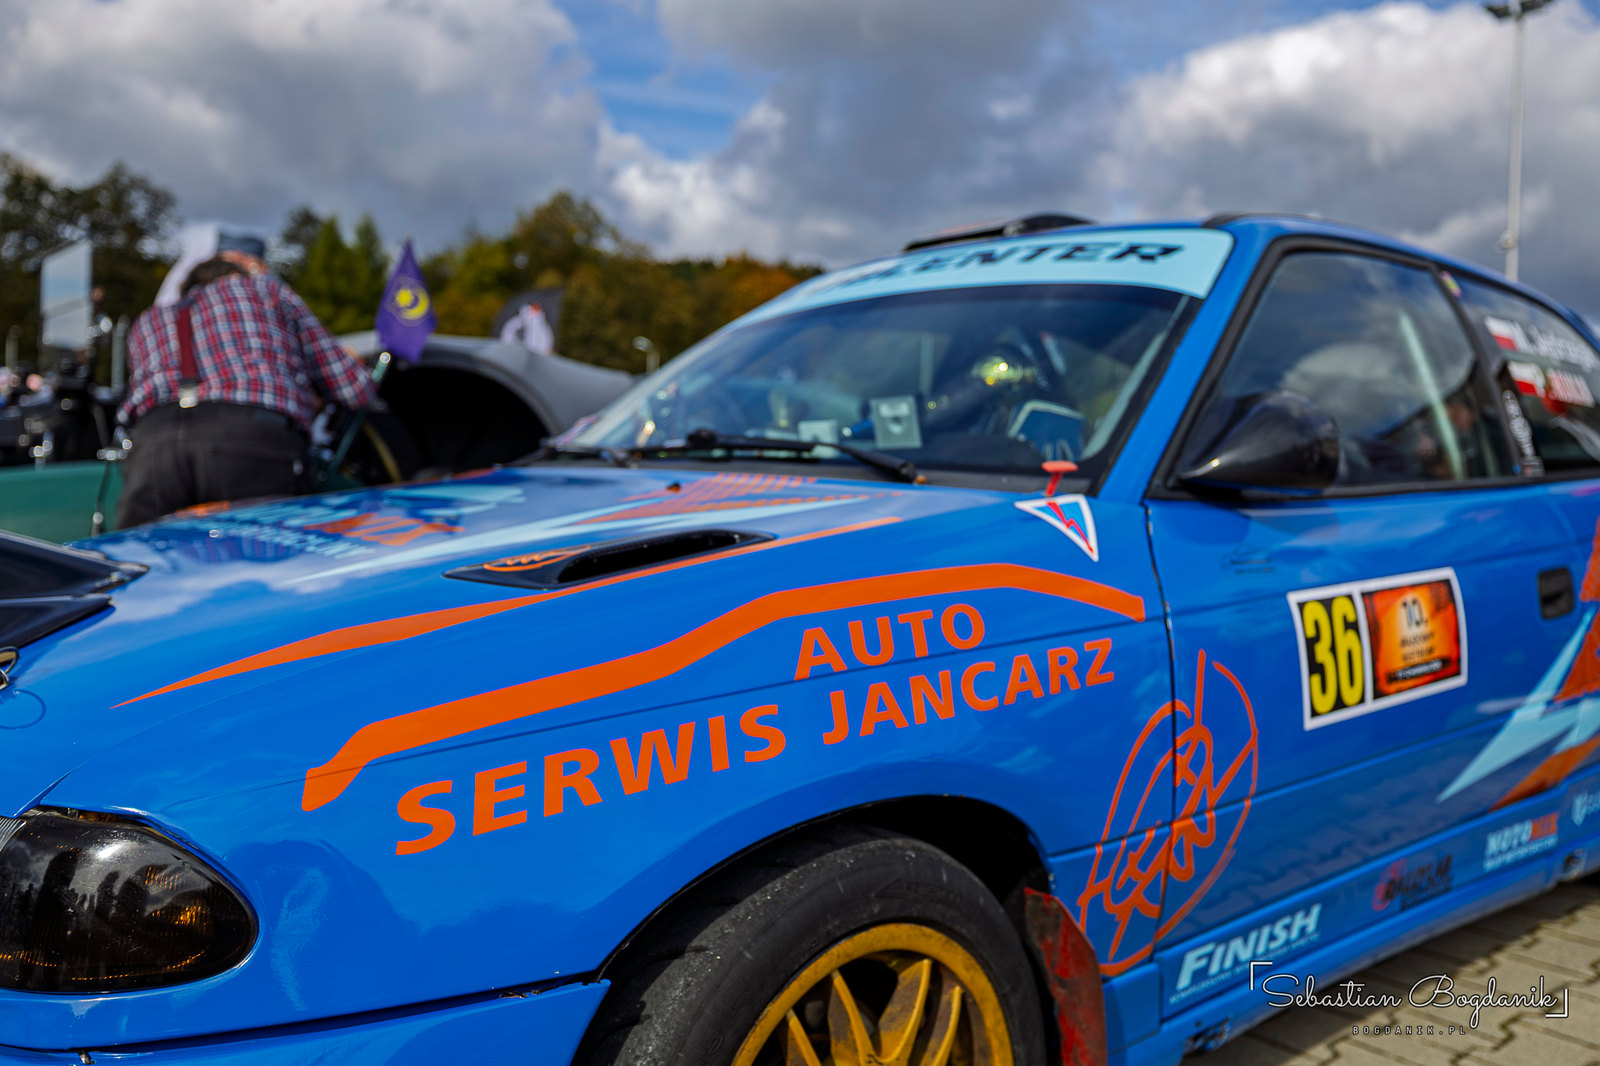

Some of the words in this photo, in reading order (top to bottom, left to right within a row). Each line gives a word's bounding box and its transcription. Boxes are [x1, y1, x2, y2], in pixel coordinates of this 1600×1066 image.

[794, 604, 985, 681] AUTO
[1303, 597, 1364, 714] 36
[395, 704, 786, 856] SERWIS
[822, 638, 1114, 745] JANCARZ
[1175, 903, 1322, 991] FINISH
